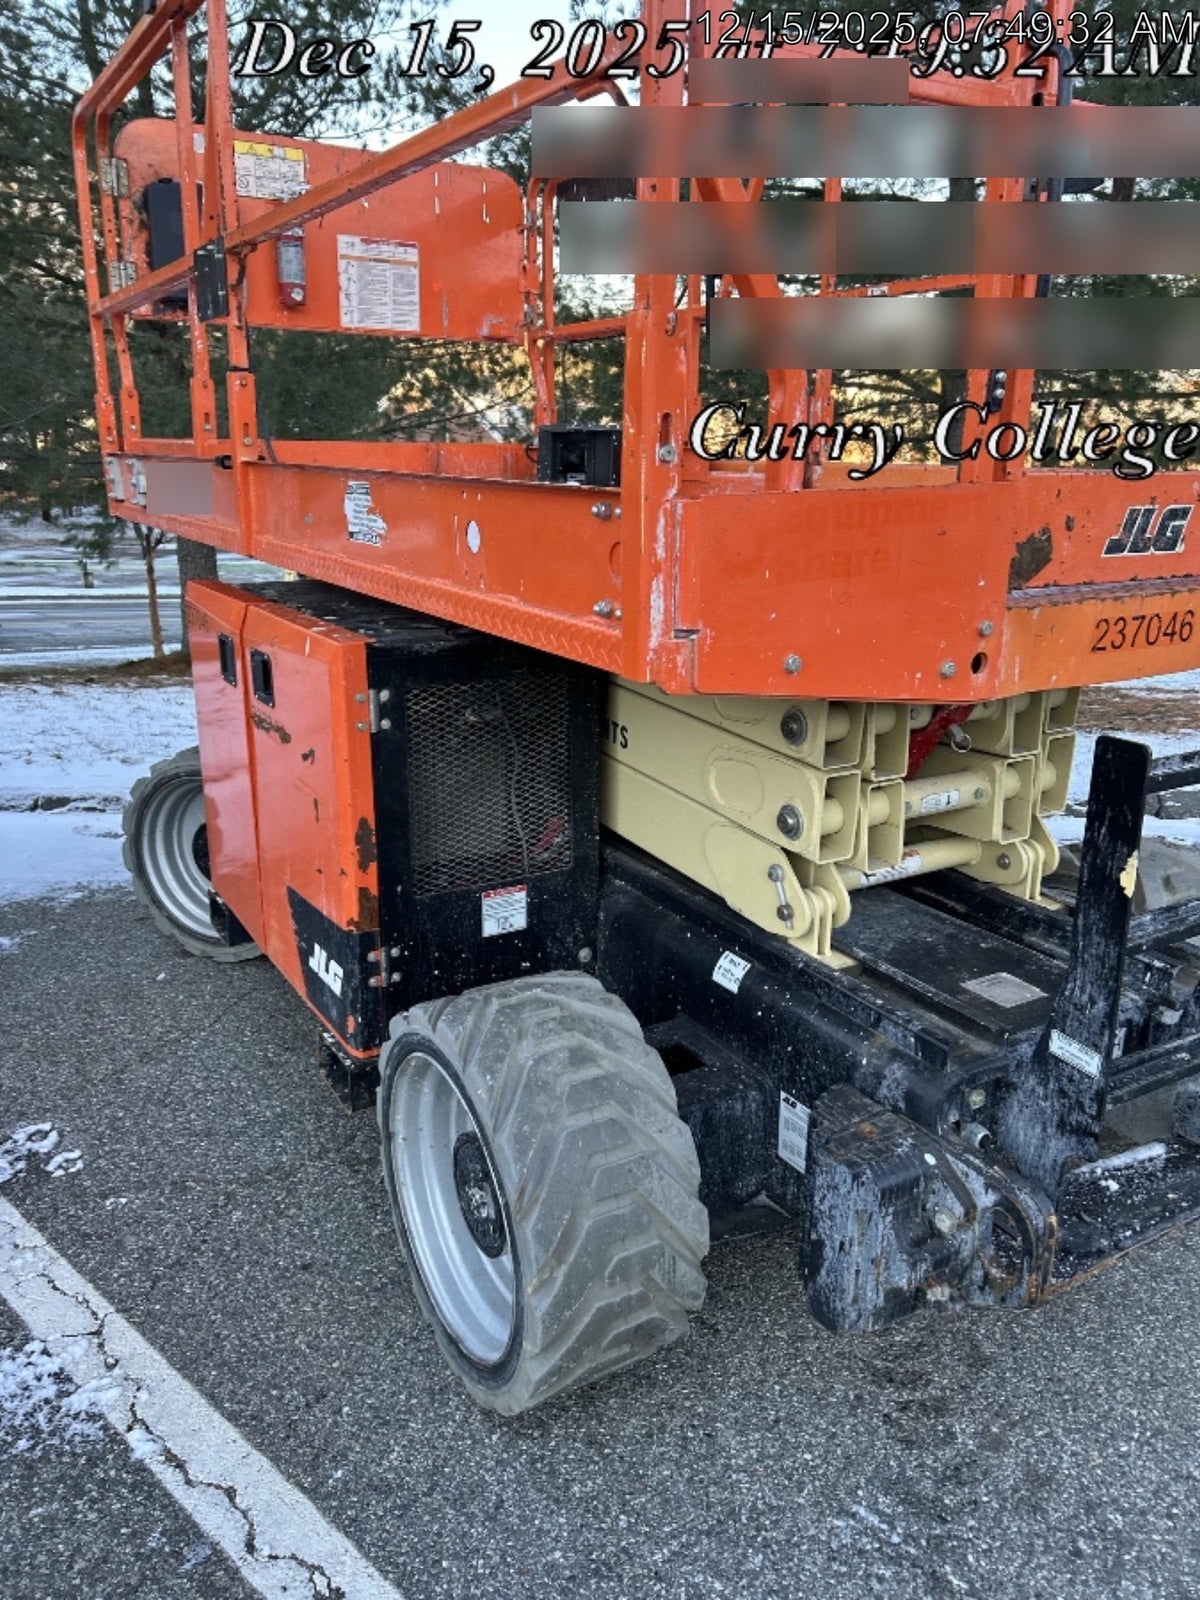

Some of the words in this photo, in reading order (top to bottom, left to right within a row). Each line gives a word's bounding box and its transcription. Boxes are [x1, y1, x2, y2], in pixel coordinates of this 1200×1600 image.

[1101, 504, 1195, 557] JLG
[1091, 609, 1194, 653] 237046
[308, 941, 344, 998] JLG
